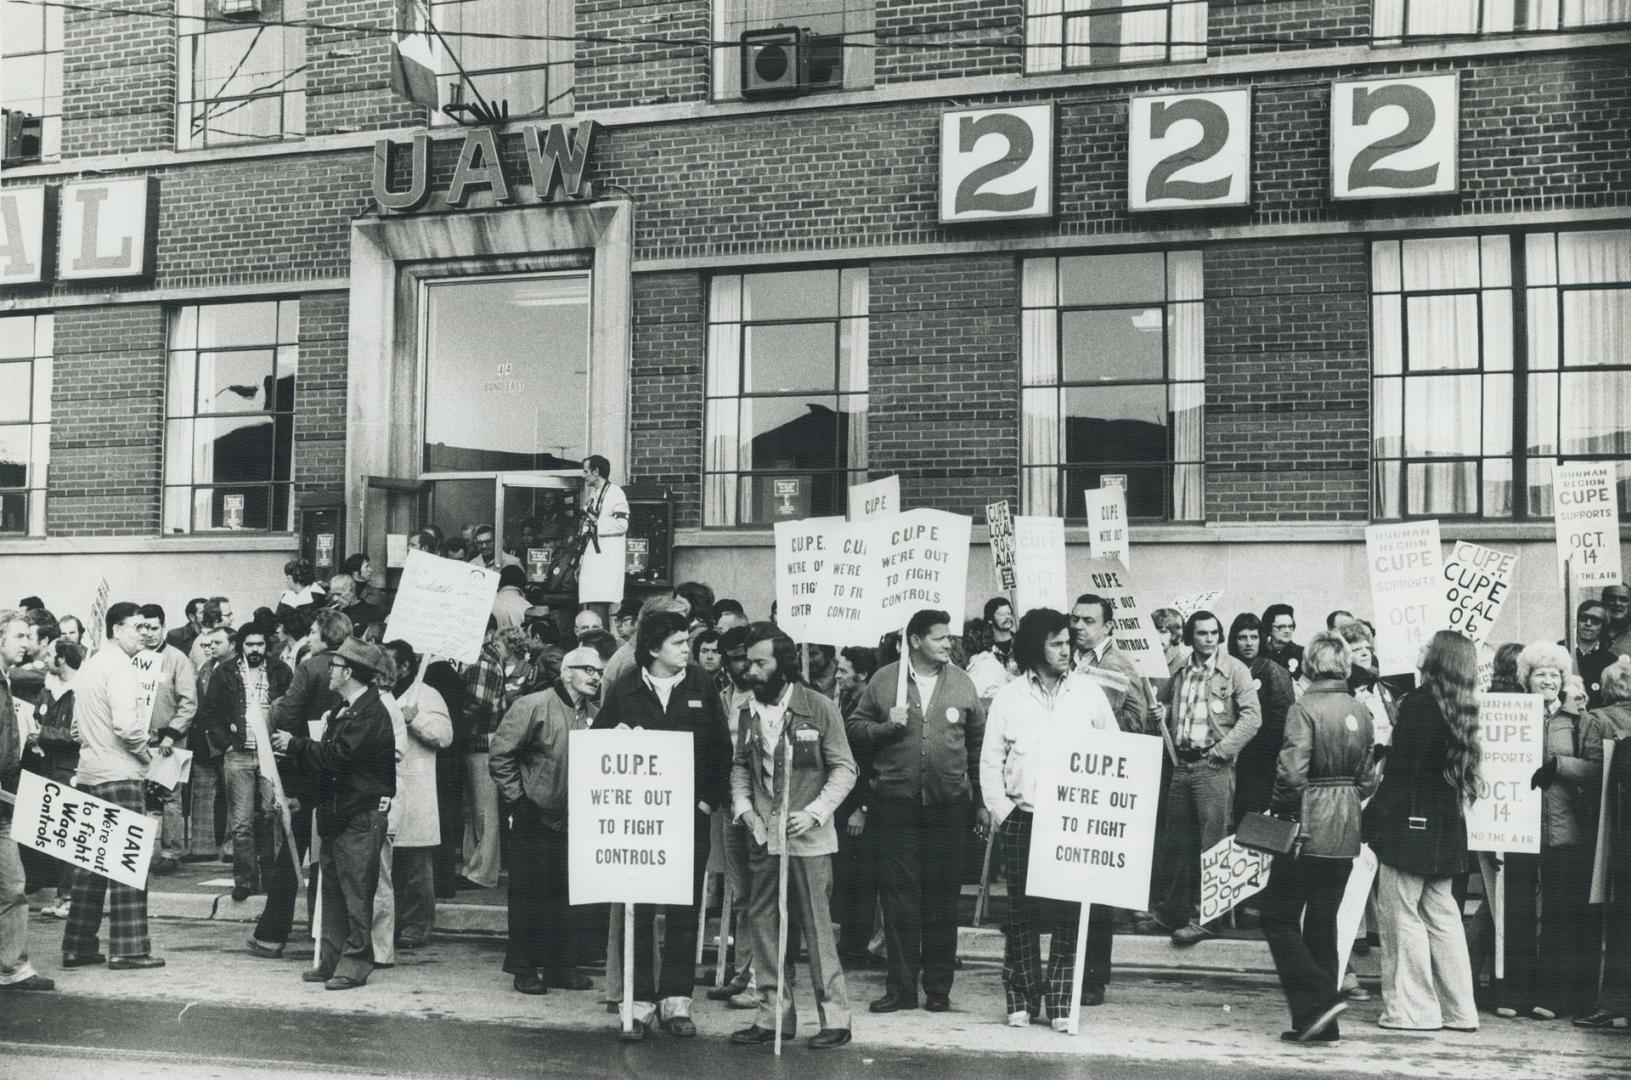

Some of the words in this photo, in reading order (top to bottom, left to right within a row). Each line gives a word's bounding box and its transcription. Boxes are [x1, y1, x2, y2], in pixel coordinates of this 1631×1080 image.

[373, 119, 602, 210] UAW
[1559, 488, 1610, 505] CUPE
[988, 501, 1009, 523] CUPE
[1560, 509, 1612, 521] SUPPORTS
[989, 521, 1013, 538] LOCAL
[881, 548, 916, 569] WE'RE
[924, 548, 950, 564] OUT
[995, 550, 1016, 568] AJAX
[1375, 550, 1433, 573] CUPE
[1457, 544, 1515, 574] CUPE
[1583, 549, 1598, 565] 14
[833, 562, 863, 577] WE'RE
[886, 573, 899, 587] TO
[905, 567, 941, 583] FIGHT
[801, 582, 818, 595] FIG
[833, 584, 845, 597] TO
[1444, 562, 1507, 605] CUPE
[881, 587, 941, 609] CONTROLS
[1121, 596, 1136, 608] OUT
[1446, 587, 1494, 622] OCAL
[791, 603, 812, 617] CONTR
[1449, 607, 1478, 633] 06
[1119, 617, 1141, 631] FIGHT
[1116, 638, 1150, 651] CONTROLS
[1405, 625, 1424, 646] 14
[131, 656, 153, 671] AW
[601, 753, 662, 775] C.U.P.E.
[1069, 752, 1129, 779] C.U.P.E.
[1482, 752, 1534, 764] PPORTS
[590, 788, 632, 805] WE'RE
[644, 790, 672, 806] OUT
[1057, 785, 1100, 805] WE'RE
[1109, 791, 1138, 810] OUT
[35, 782, 61, 849] Controls
[82, 800, 100, 816] to
[1492, 802, 1511, 823] 14
[53, 802, 79, 849] Wage
[99, 807, 121, 844] We're
[598, 818, 615, 835] TO
[623, 819, 664, 836] FIGHT
[1061, 815, 1079, 833] TO
[1086, 818, 1127, 839] FIGHT
[73, 821, 95, 863] fight
[1487, 832, 1506, 843] THE
[94, 846, 109, 873] out
[121, 824, 144, 874] UAW
[595, 848, 667, 866] CONTROLS
[1055, 845, 1126, 869] CONTROLS
[1203, 851, 1219, 918] CUPE
[1219, 839, 1232, 913] LOCAL
